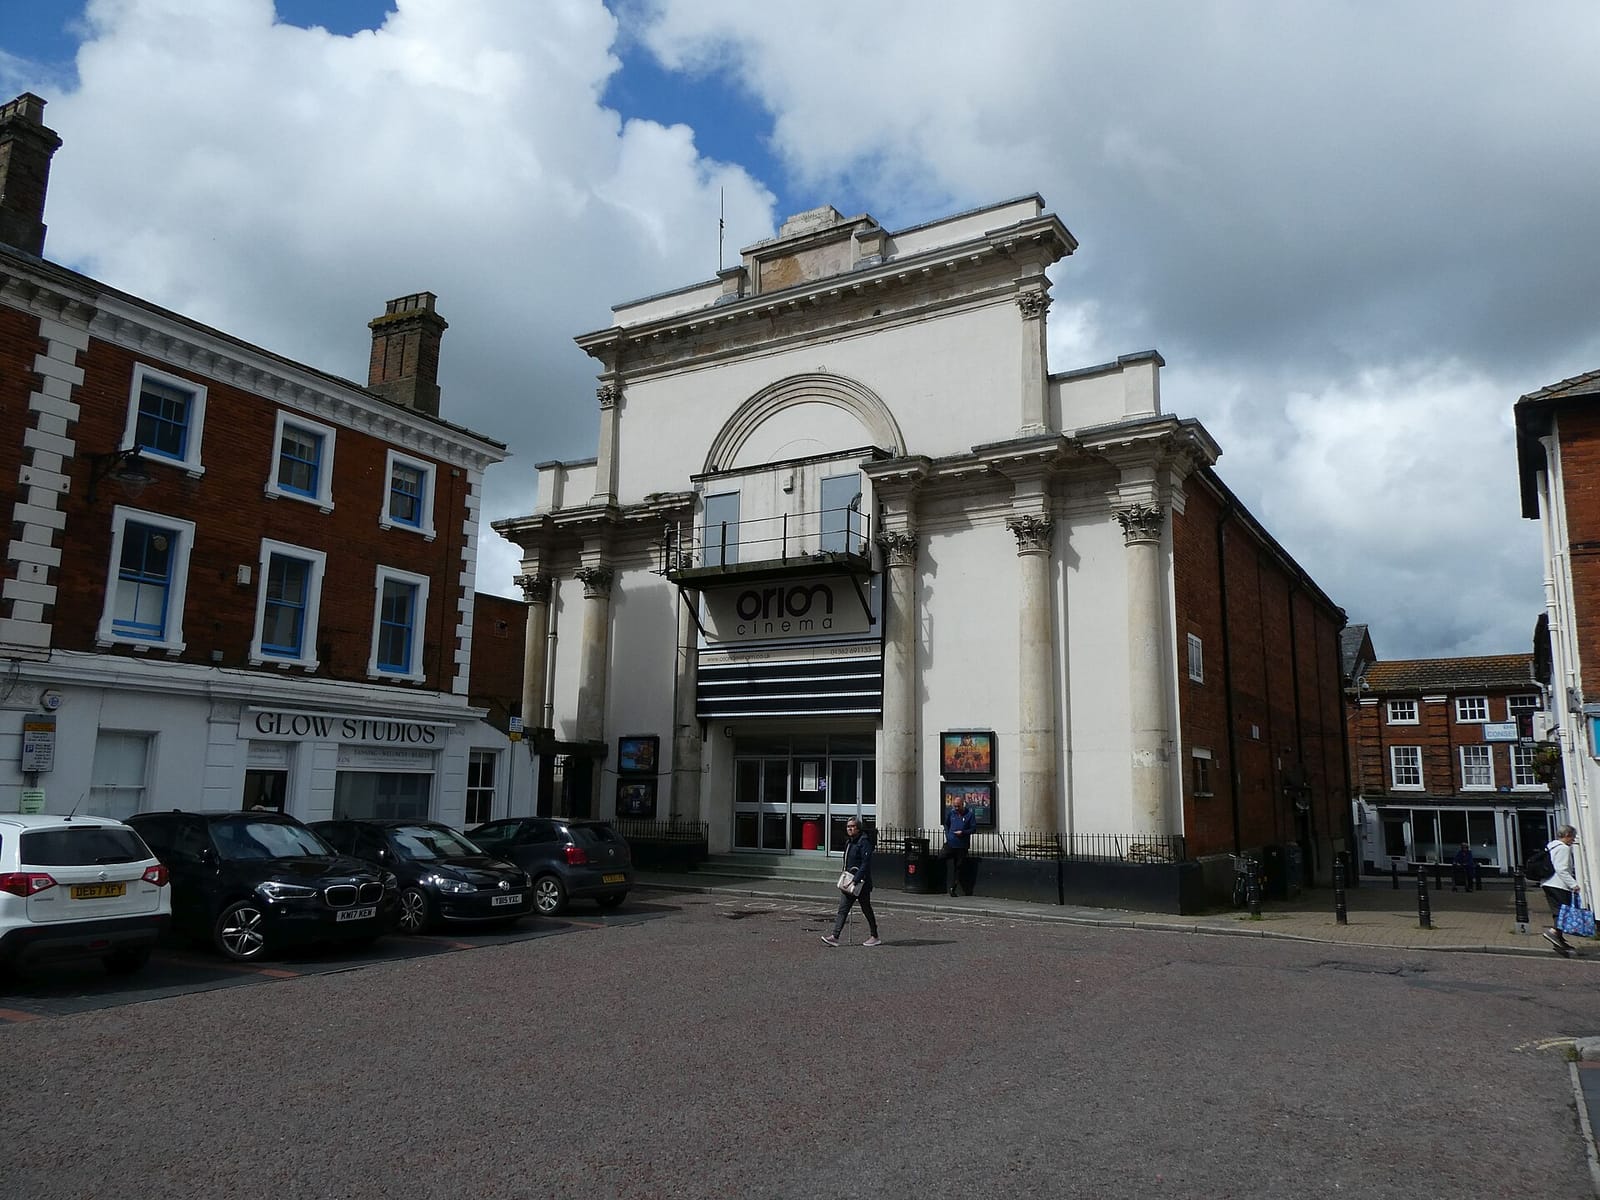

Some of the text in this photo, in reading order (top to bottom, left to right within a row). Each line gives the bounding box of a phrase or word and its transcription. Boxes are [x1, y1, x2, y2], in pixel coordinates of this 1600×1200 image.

[736, 583, 834, 621] orion
[737, 617, 833, 636] cinema
[255, 711, 436, 744] GLOW STUDIOS
